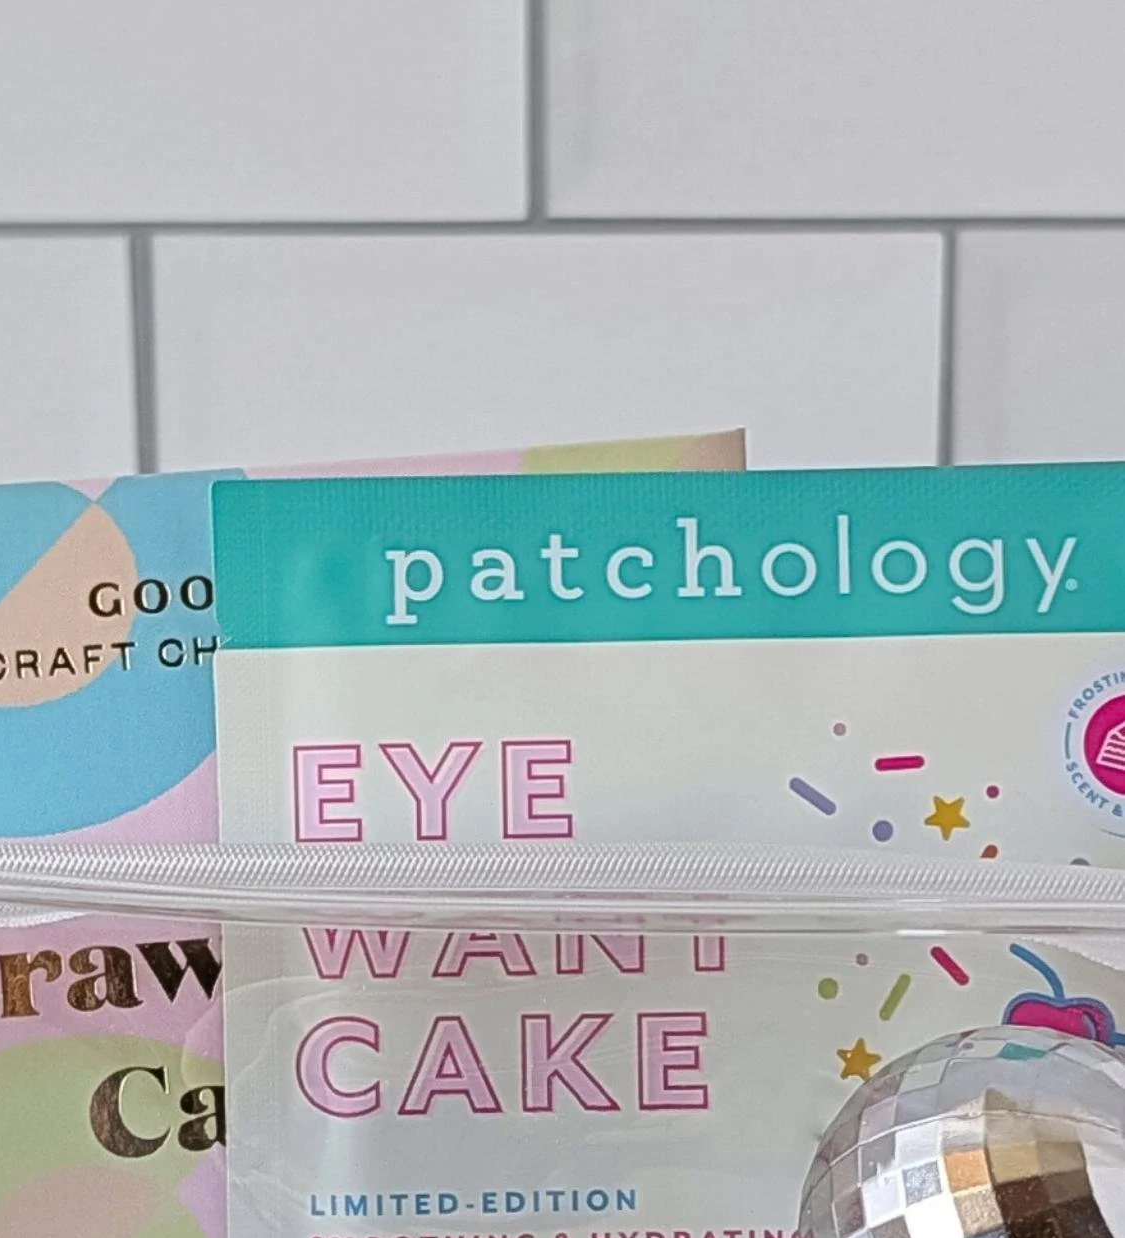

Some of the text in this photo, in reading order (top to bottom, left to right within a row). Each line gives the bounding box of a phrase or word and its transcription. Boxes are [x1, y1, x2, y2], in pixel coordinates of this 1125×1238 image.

[88, 575, 214, 617] GOO
[158, 636, 219, 668] CH
[293, 740, 573, 842] EYE
[1066, 761, 1123, 817] SCENT &
[295, 1012, 708, 1117] CAKE
[90, 1065, 225, 1159] Ca
[310, 1189, 637, 1216] LIMITED-EDITION
